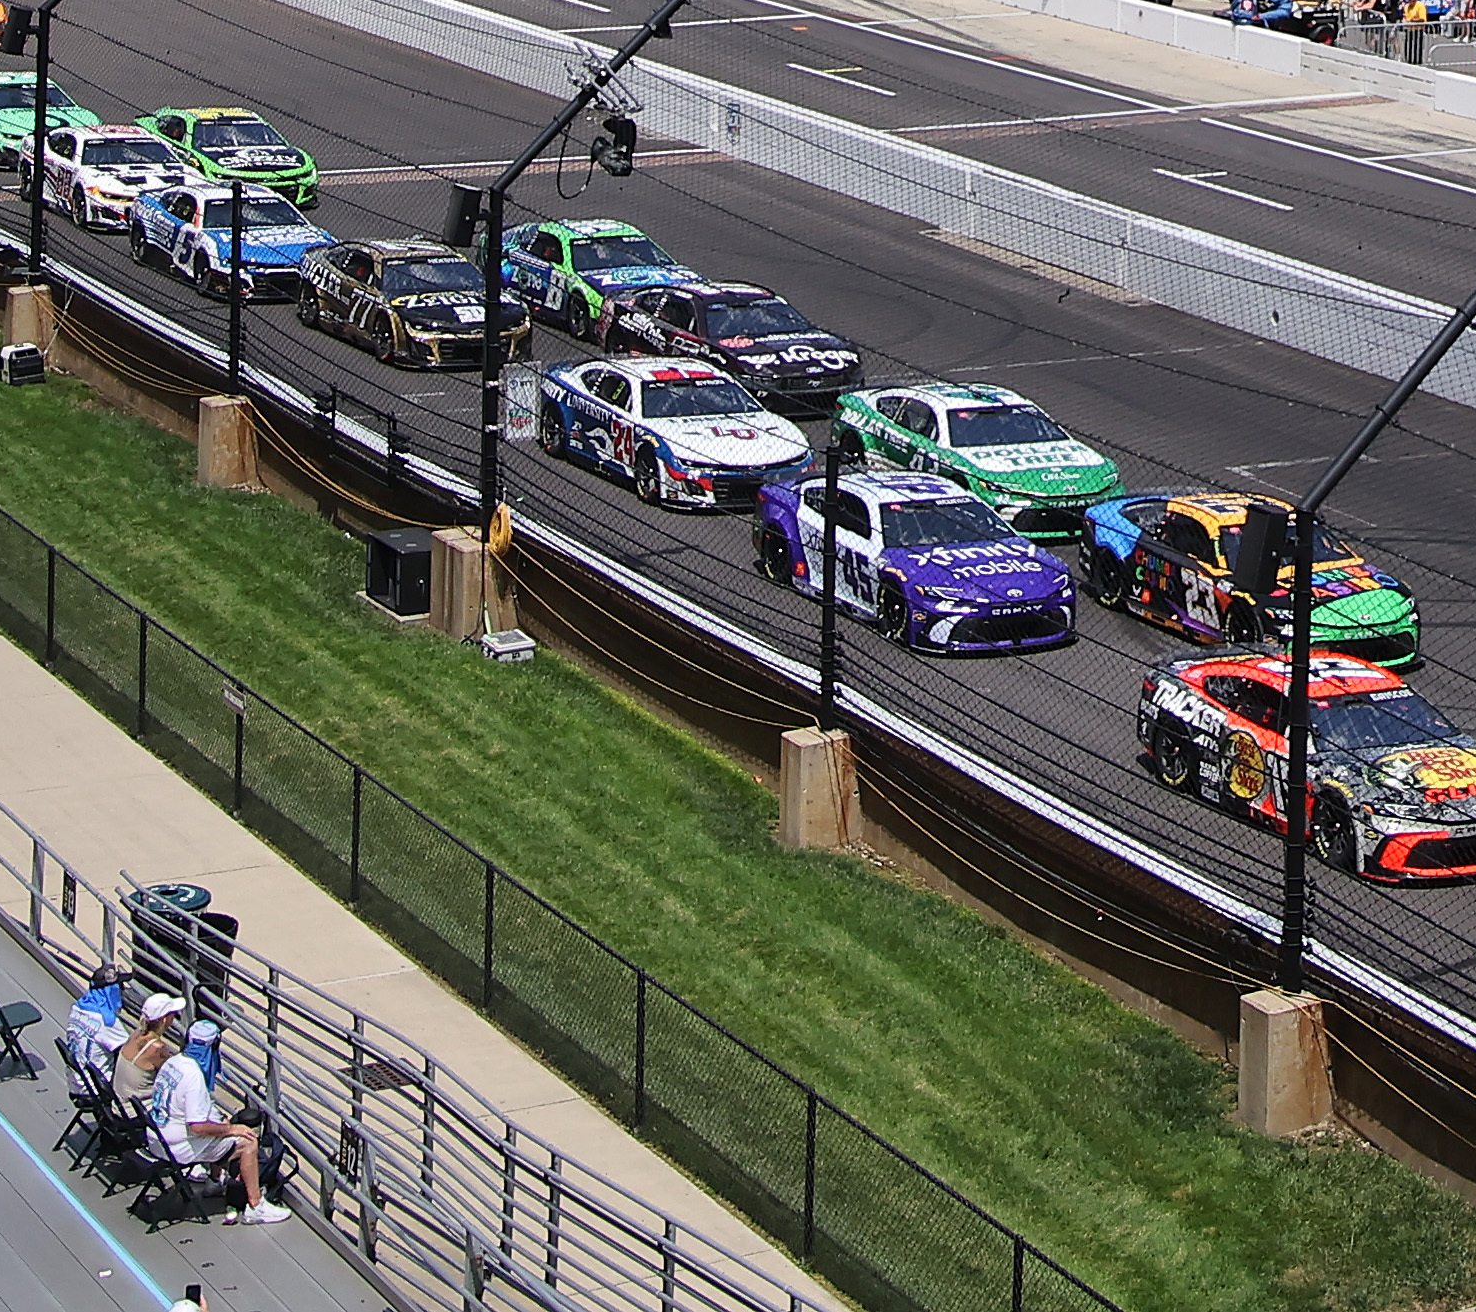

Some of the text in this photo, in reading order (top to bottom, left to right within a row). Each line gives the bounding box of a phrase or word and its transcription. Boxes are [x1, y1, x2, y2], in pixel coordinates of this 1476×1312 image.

[348, 287, 376, 331] 77
[779, 345, 859, 370] Kroger
[566, 388, 613, 425] UNIVERSITY
[611, 420, 635, 466] 24
[972, 442, 1090, 461] DOLLAR
[1003, 452, 1079, 468] TREE
[907, 544, 1037, 567] xfinity
[951, 560, 1043, 580] mobile
[1181, 567, 1220, 630] 23
[991, 605, 1043, 617] CAMRY
[1370, 688, 1414, 702] BRISCOE
[1151, 678, 1227, 738] TRACKER
[1408, 748, 1463, 763] Bass
